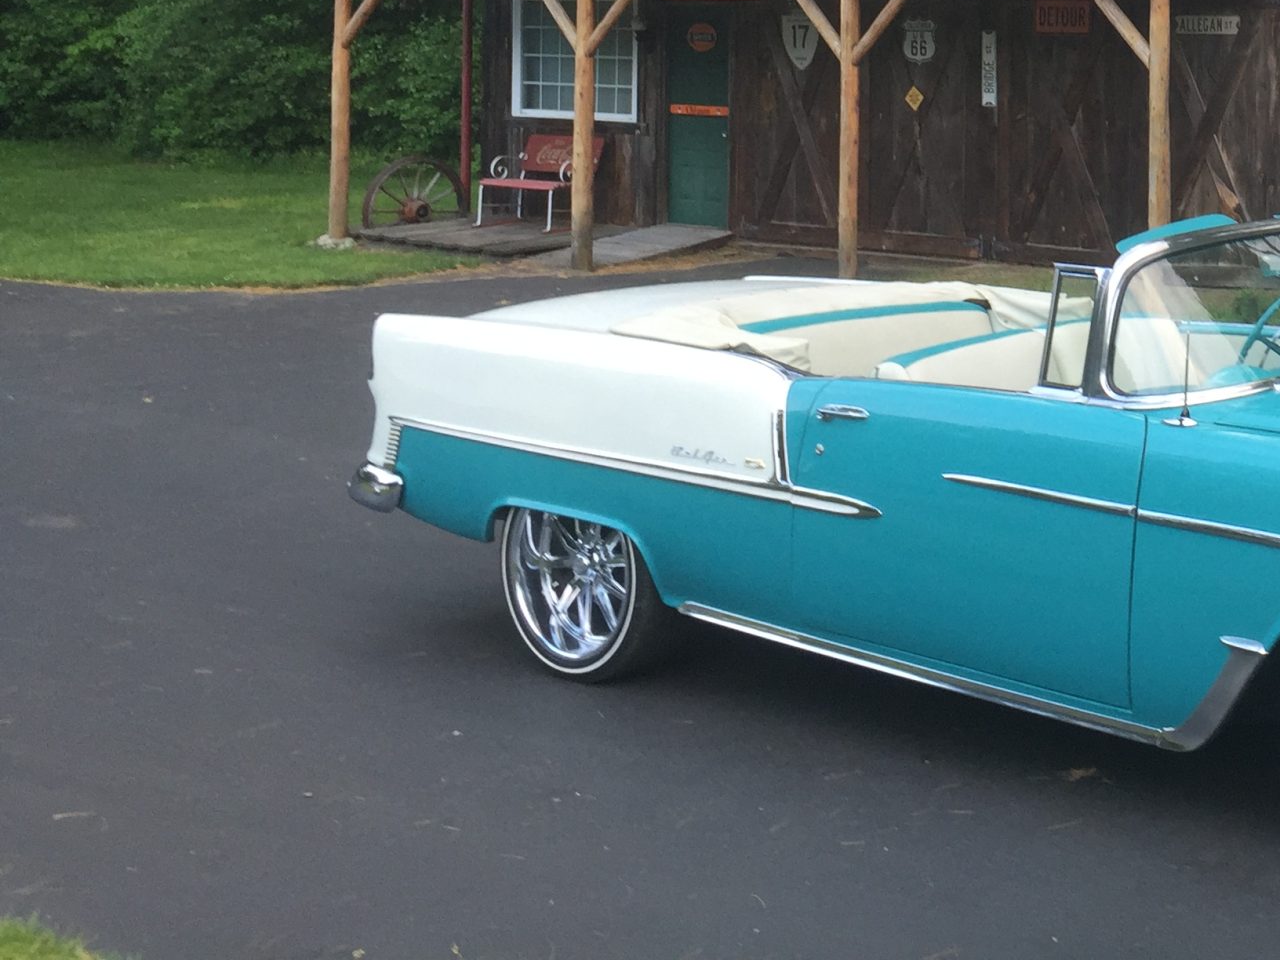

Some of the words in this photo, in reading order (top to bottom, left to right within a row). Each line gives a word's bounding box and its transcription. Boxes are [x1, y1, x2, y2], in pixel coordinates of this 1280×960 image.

[1038, 6, 1086, 27] DETOUR
[1179, 17, 1223, 32] ALLEGAN
[791, 25, 810, 49] 17
[910, 40, 927, 56] 66
[983, 61, 995, 93] BRIDGE
